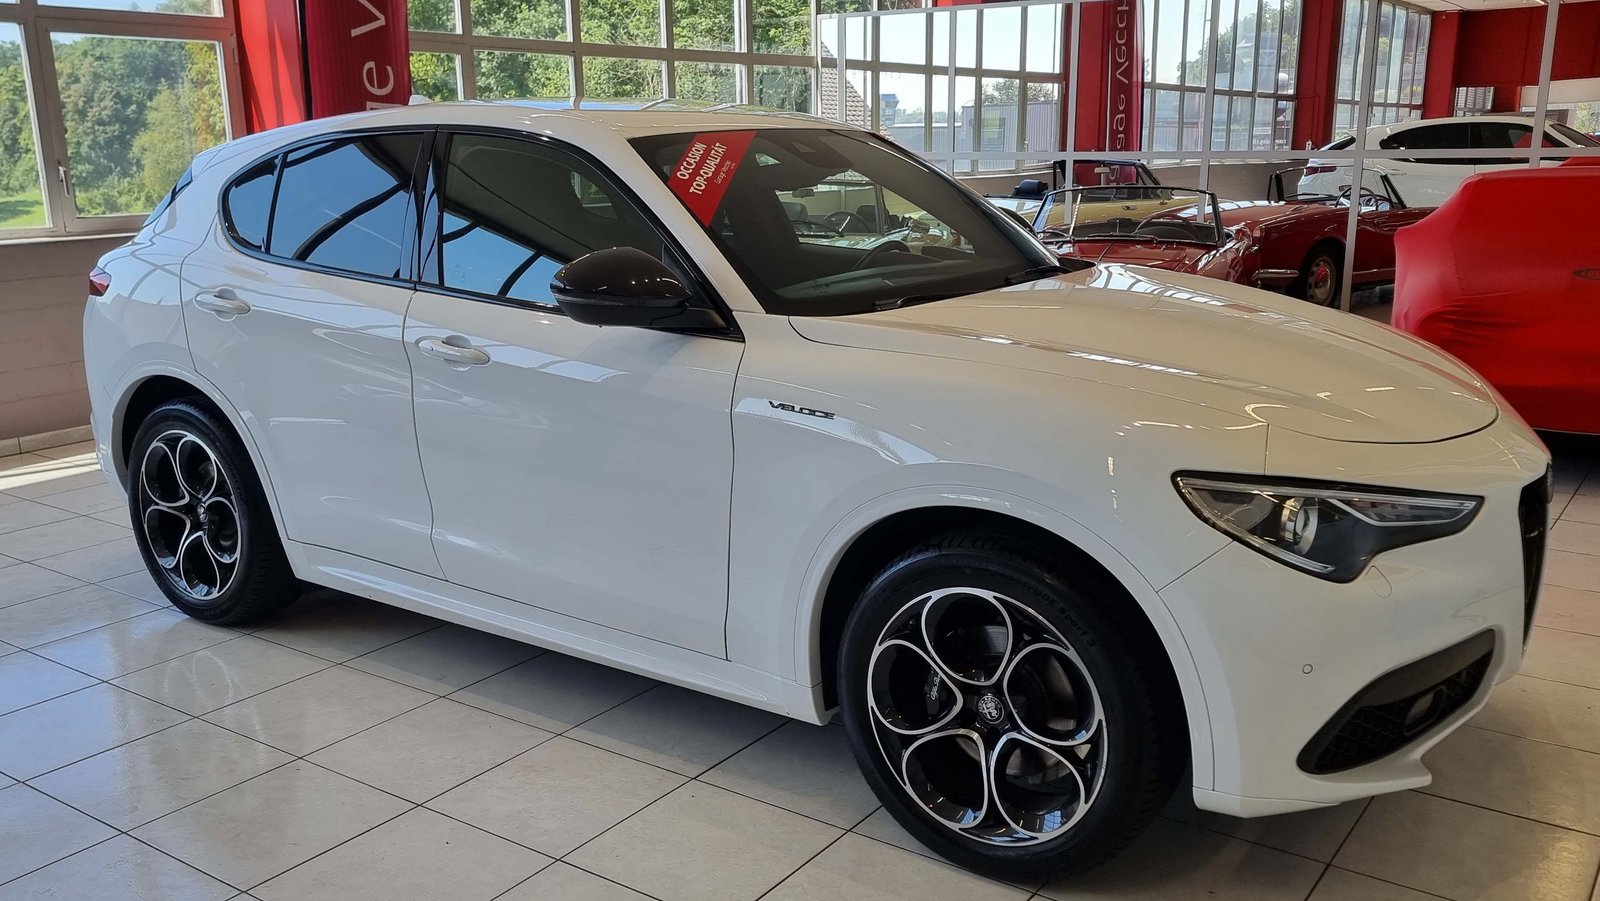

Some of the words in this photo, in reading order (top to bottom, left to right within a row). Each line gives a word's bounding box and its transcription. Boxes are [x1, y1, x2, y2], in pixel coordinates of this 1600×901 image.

[676, 141, 707, 180] OCCASION
[689, 142, 728, 195] TOP-QUALITÄT
[768, 400, 836, 420] VELOCE
